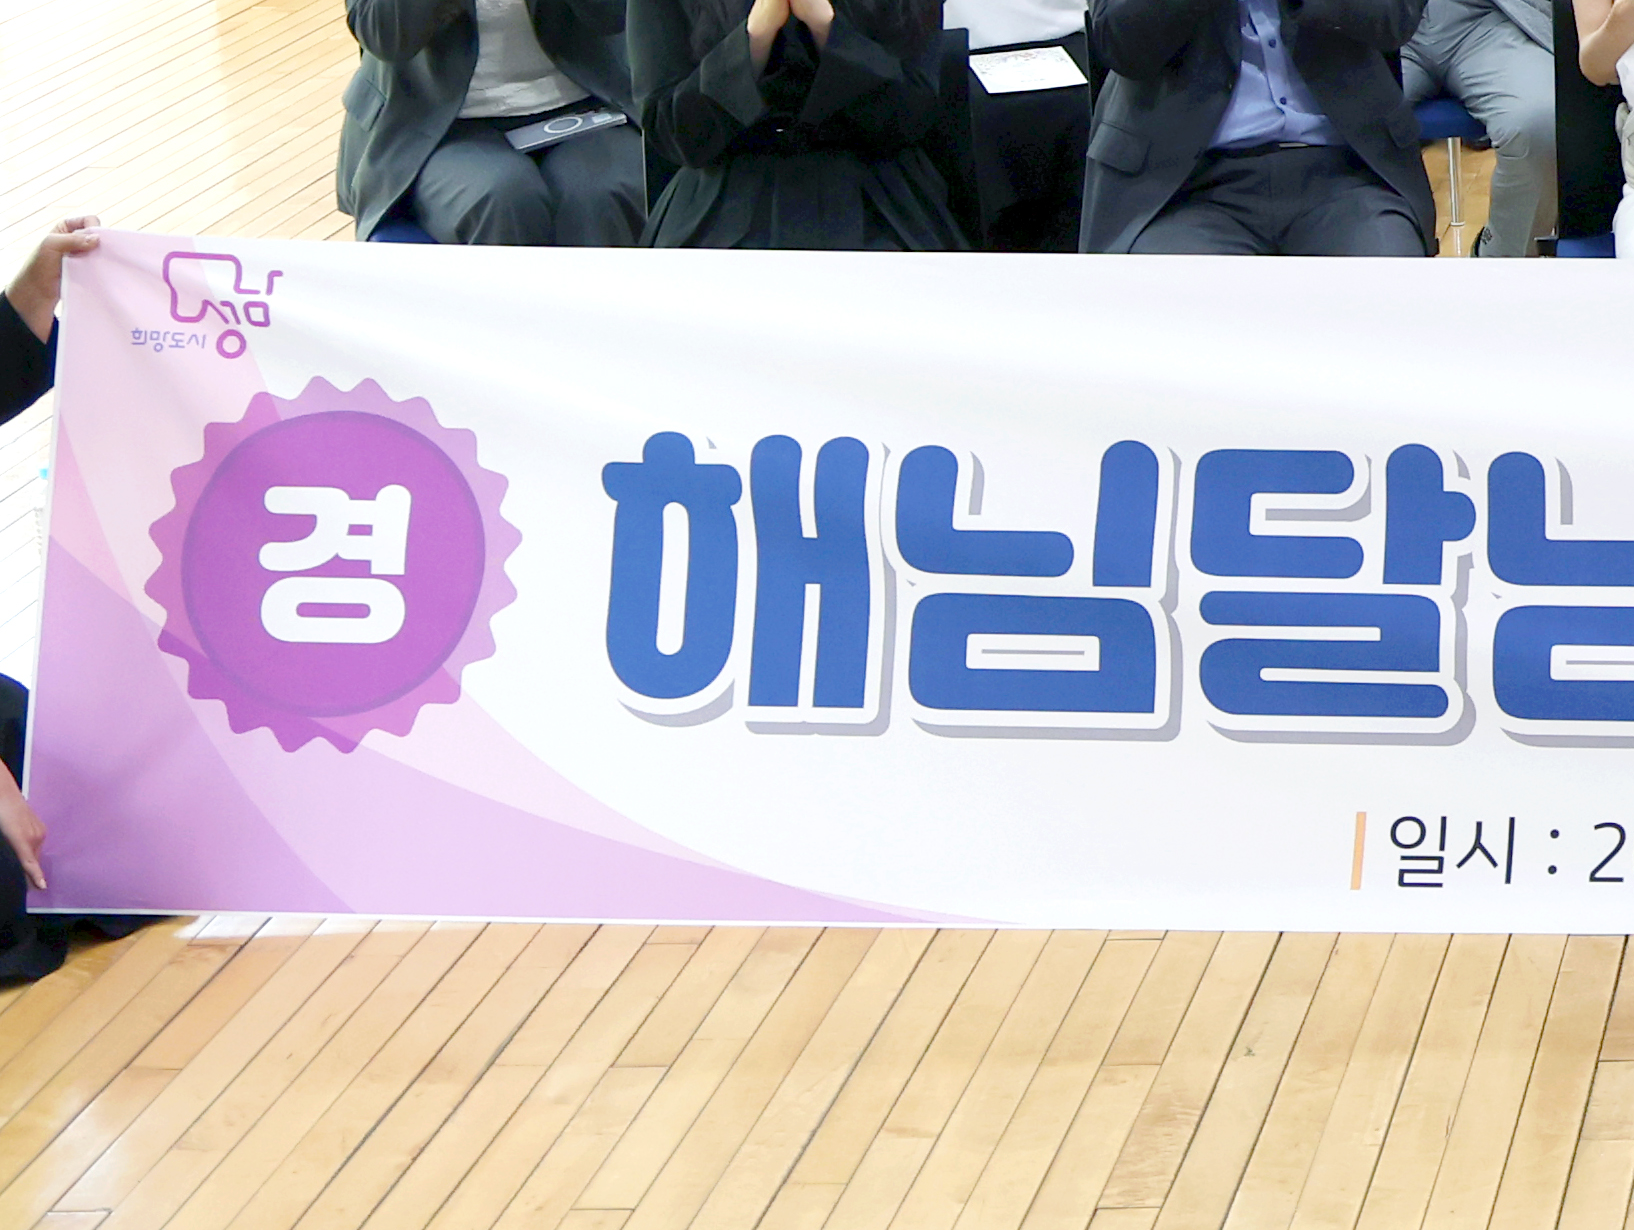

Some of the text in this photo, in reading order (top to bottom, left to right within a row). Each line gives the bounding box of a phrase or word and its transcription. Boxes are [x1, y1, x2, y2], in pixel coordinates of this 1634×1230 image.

[131, 328, 206, 353] 희망도시
[258, 483, 410, 645] 경
[1389, 815, 1515, 887] 일시
